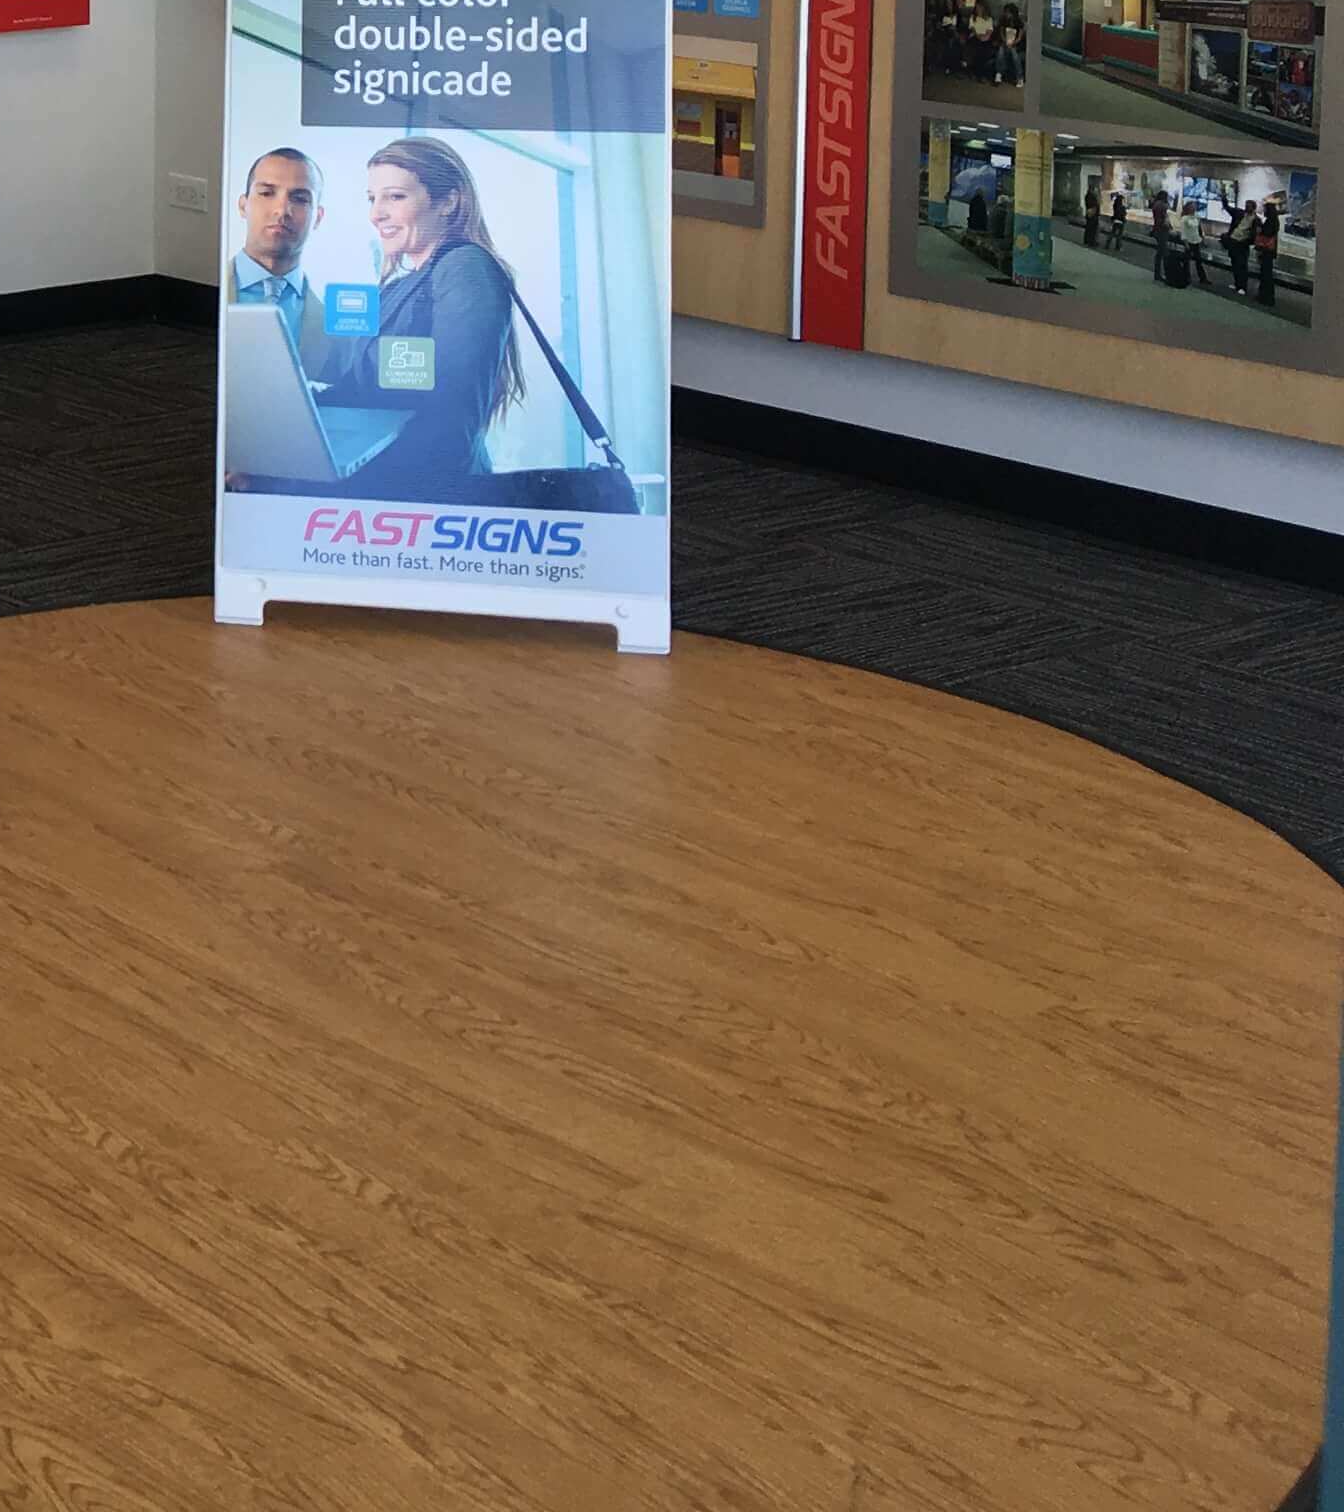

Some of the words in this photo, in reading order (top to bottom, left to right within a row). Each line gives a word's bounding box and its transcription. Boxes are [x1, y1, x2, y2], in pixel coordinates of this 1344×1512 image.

[334, 15, 588, 53] double-sided
[334, 60, 512, 105] signicade
[303, 547, 346, 564] More
[353, 552, 390, 568] than
[398, 553, 433, 570] fast.
[440, 556, 483, 573] More
[490, 559, 529, 576] than
